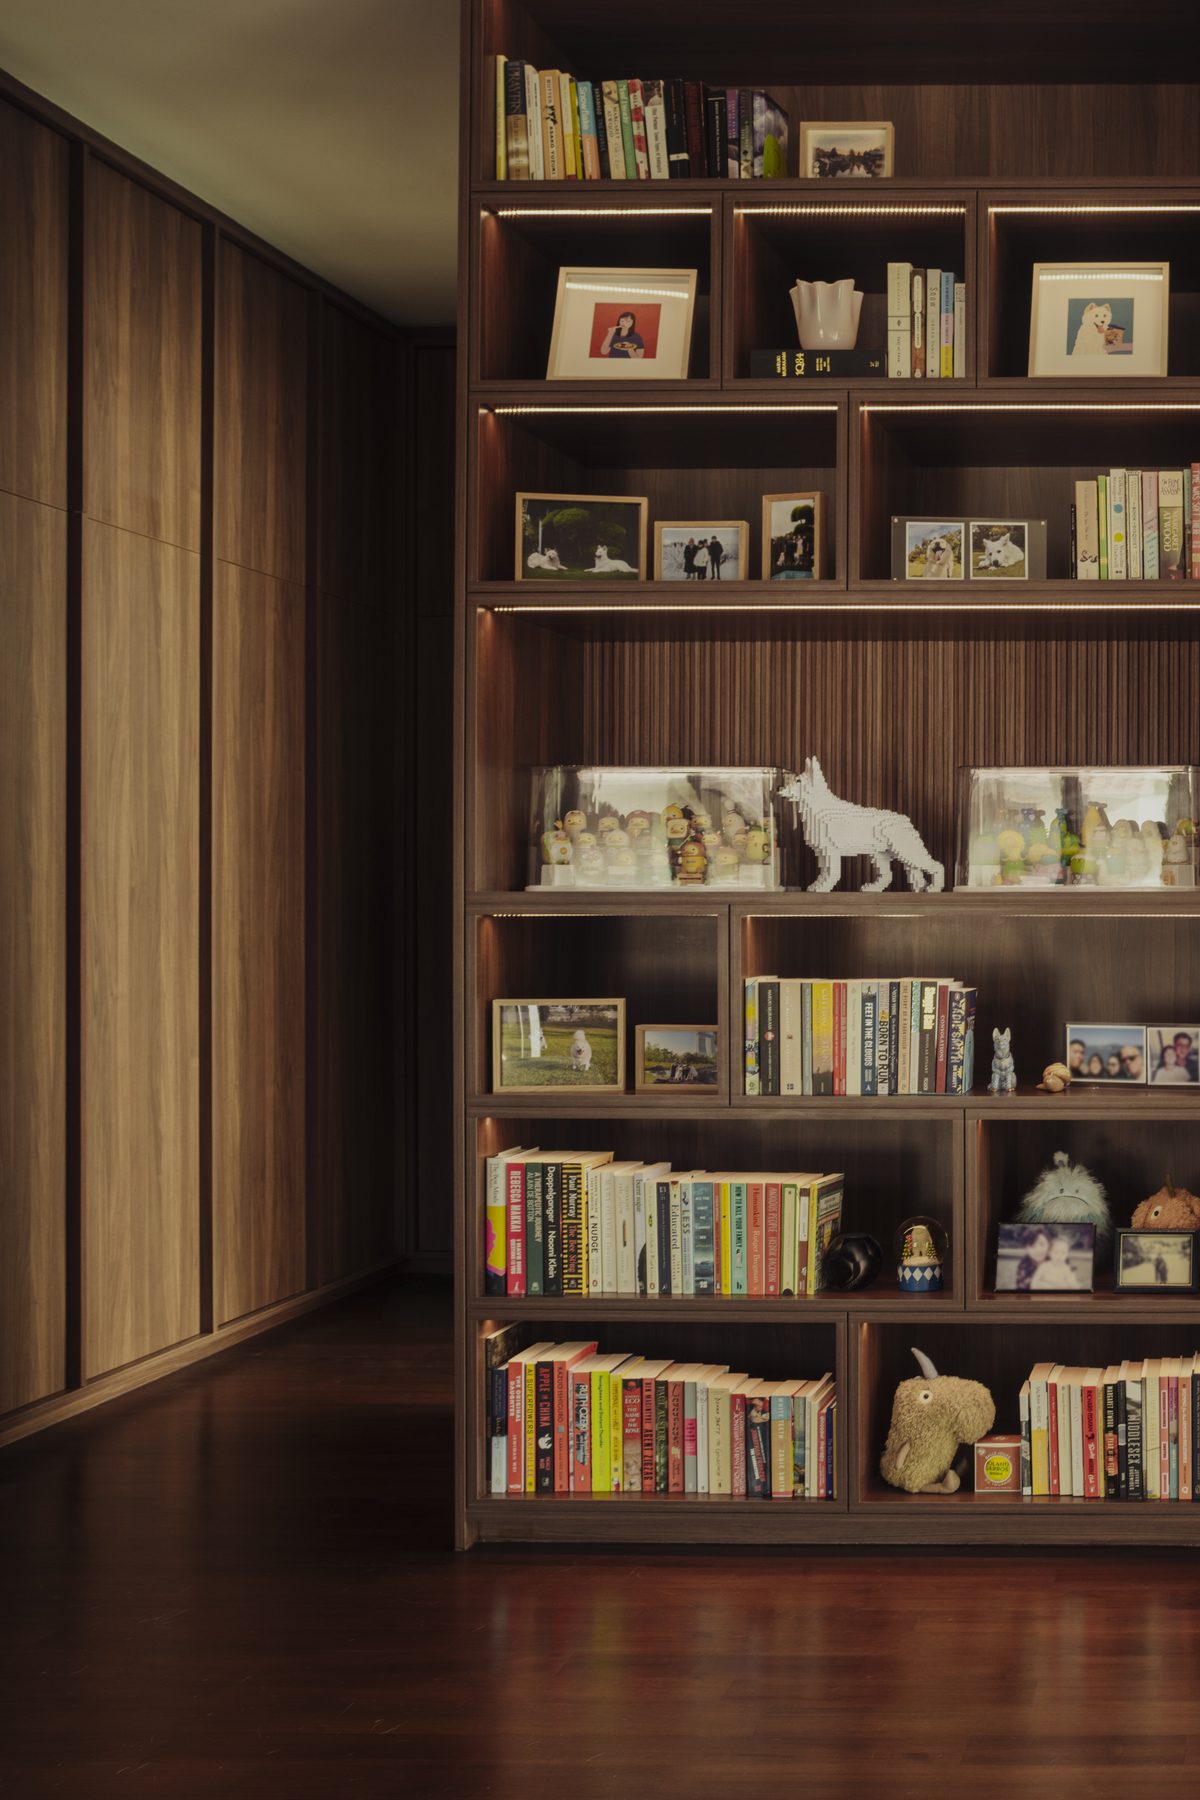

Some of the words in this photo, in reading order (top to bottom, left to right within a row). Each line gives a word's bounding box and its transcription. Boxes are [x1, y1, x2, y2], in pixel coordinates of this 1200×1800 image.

[795, 352, 805, 377] 1Q84
[1192, 470, 1200, 485] TIME
[1192, 486, 1200, 500] WAS
[1163, 511, 1172, 552] ATWOOD
[1171, 511, 1179, 552] MARGARET
[864, 1003, 873, 1017] FEET
[952, 1001, 962, 1030] ZADIE
[864, 1018, 873, 1026] IN
[879, 1020, 888, 1045] BORN
[864, 1028, 873, 1041] THE
[938, 1015, 946, 1062] CONSOLATIONS
[864, 1041, 873, 1067] CLOUDS
[879, 1049, 888, 1061] TO
[950, 1031, 962, 1063] SMITH
[879, 1064, 888, 1084] RUN
[510, 1170, 522, 1203] REBECCA
[546, 1166, 557, 1223] Doppelganger
[569, 1175, 577, 1192] Paul
[735, 1186, 743, 1197] HOW
[527, 1190, 534, 1200] DE
[568, 1193, 577, 1218] Murray
[510, 1204, 522, 1232] MAKKAI
[527, 1201, 535, 1223] BOTTON
[735, 1205, 743, 1216] KILL
[753, 1188, 761, 1227] Humankind
[569, 1225, 577, 1237] The
[672, 1204, 680, 1250] Educated
[735, 1217, 743, 1230] YOUR
[769, 1213, 778, 1232] PEOPLE
[548, 1230, 556, 1257] Naomi
[569, 1239, 577, 1251] Bee
[591, 1222, 599, 1254] NUDGE
[548, 1258, 557, 1279] Klein
[568, 1253, 577, 1274] Sting
[528, 1368, 534, 1376] AI
[540, 1367, 550, 1392] APPLE
[579, 1384, 588, 1407] RUTH
[657, 1386, 665, 1407] PAUL
[1106, 1385, 1115, 1409] MARGARET
[540, 1401, 550, 1427] CHINA
[1107, 1410, 1115, 1428] ATWOOD
[657, 1410, 665, 1441] AUSTER
[643, 1429, 653, 1451] AGENT
[1127, 1414, 1141, 1465] MIDDLESEX
[643, 1455, 653, 1480] ZIGZAG
[777, 1449, 785, 1469] ZADIE
